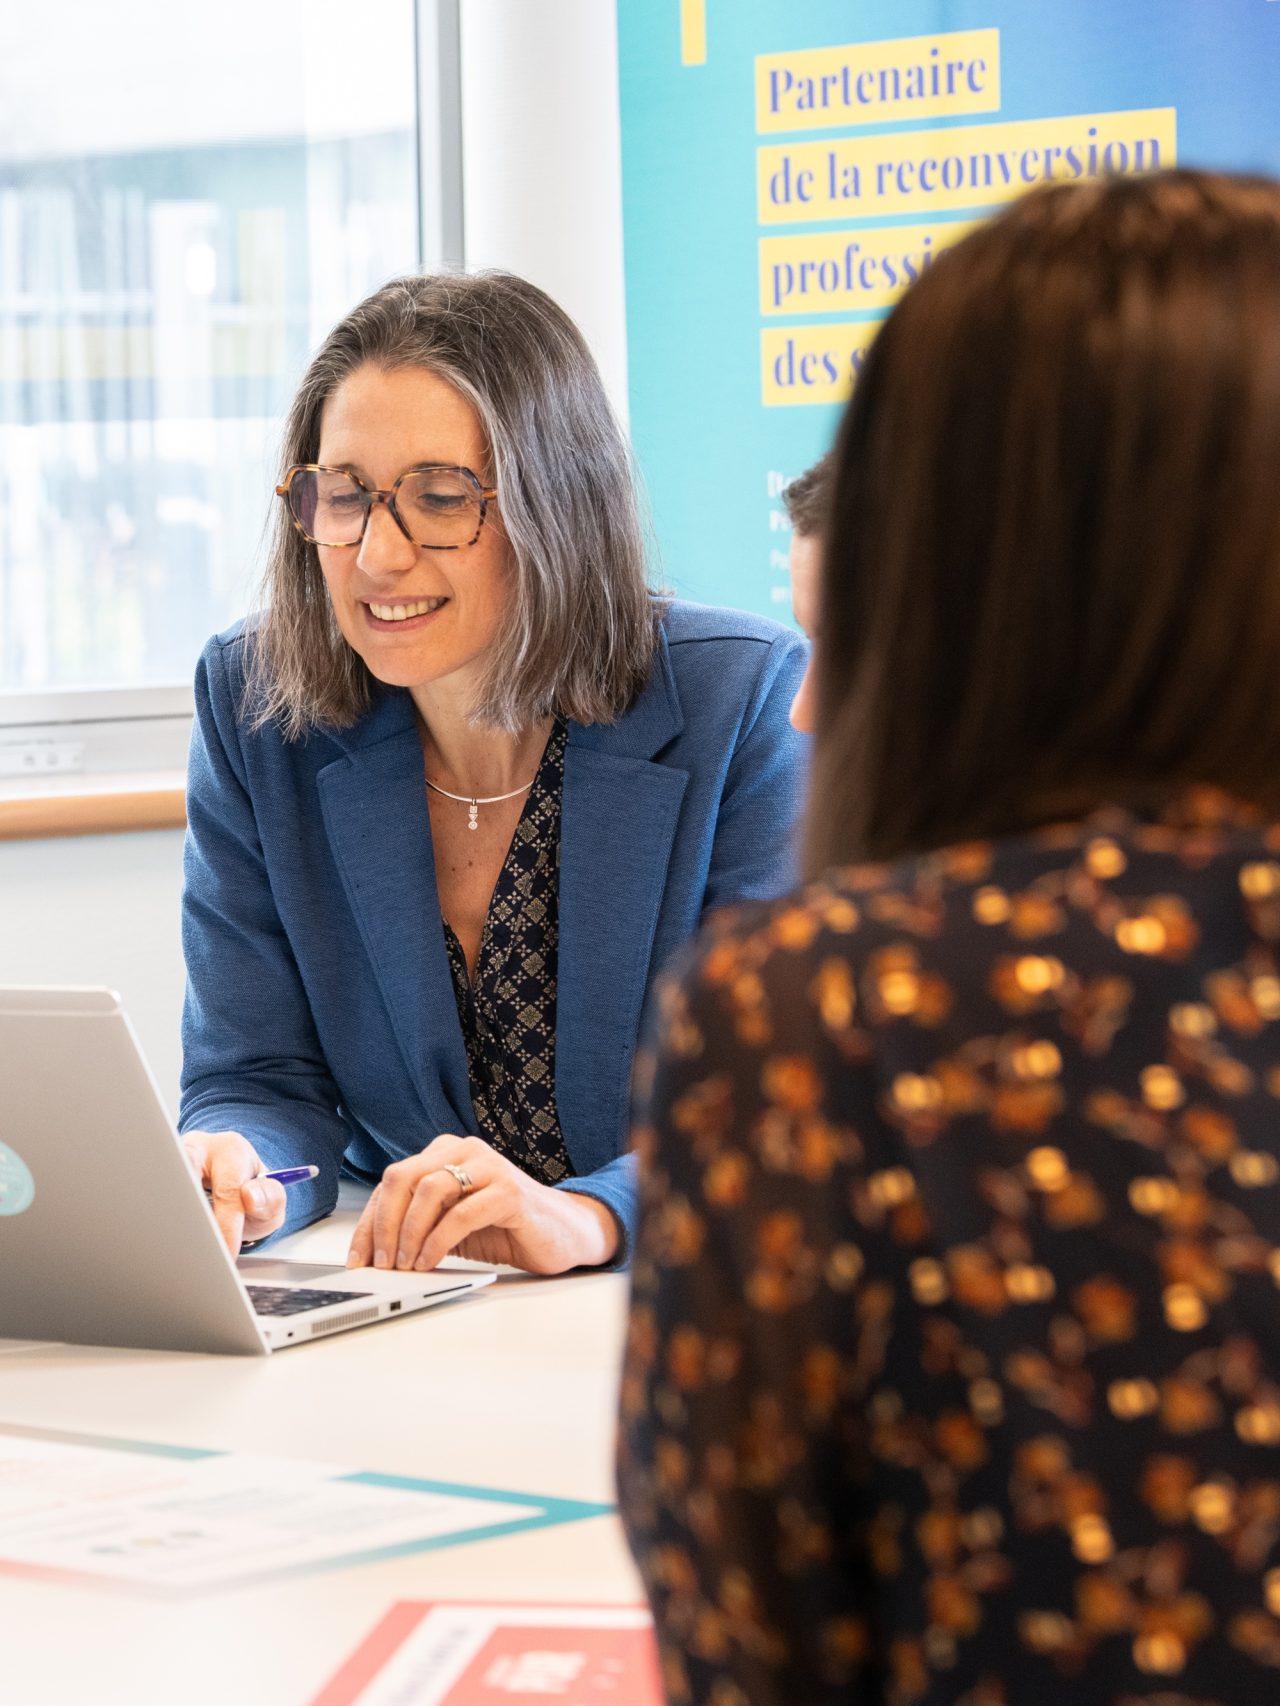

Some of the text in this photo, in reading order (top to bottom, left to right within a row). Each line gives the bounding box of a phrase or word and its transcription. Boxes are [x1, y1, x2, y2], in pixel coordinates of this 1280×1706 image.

[769, 47, 987, 113] Partenaire
[769, 127, 1161, 205] de la reconversion
[773, 339, 839, 387] des
